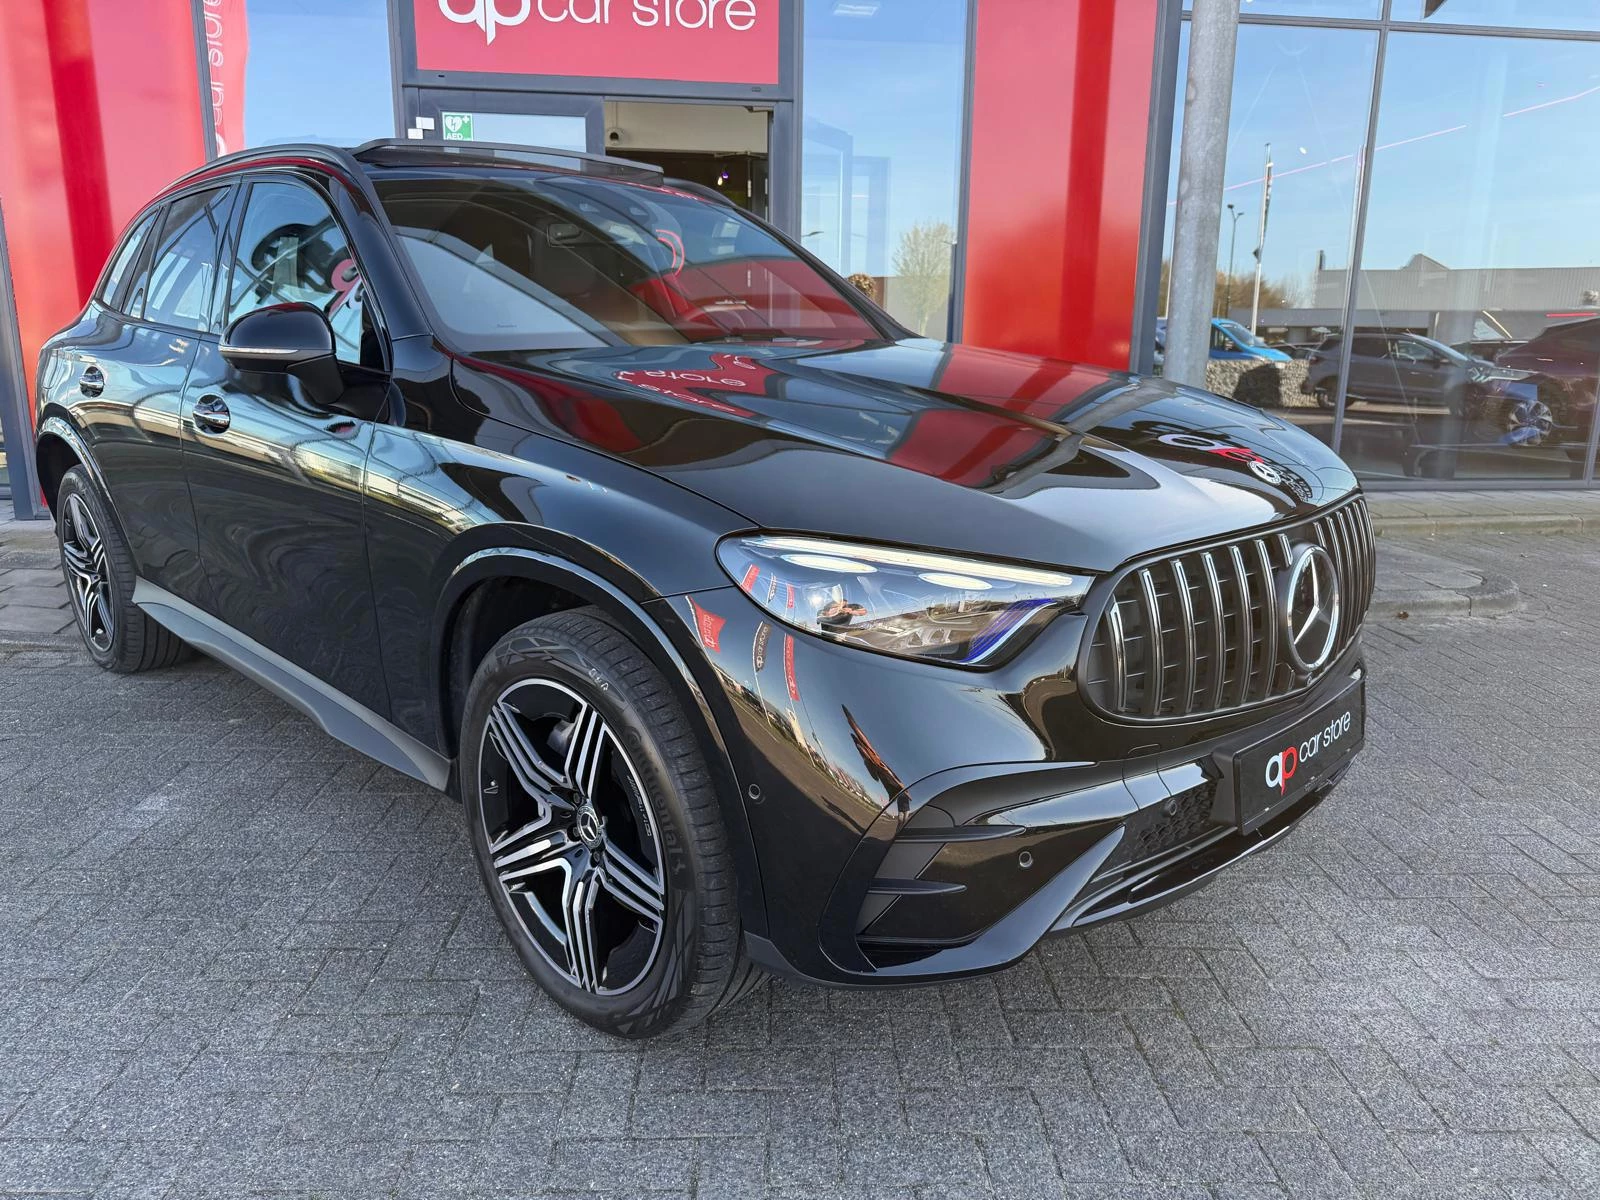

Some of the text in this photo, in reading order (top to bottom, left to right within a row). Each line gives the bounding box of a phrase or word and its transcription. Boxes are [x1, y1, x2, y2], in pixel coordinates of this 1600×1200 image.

[537, 0, 612, 24] car
[632, 0, 757, 31] store
[1299, 731, 1322, 763] car
[1322, 711, 1351, 748] store
